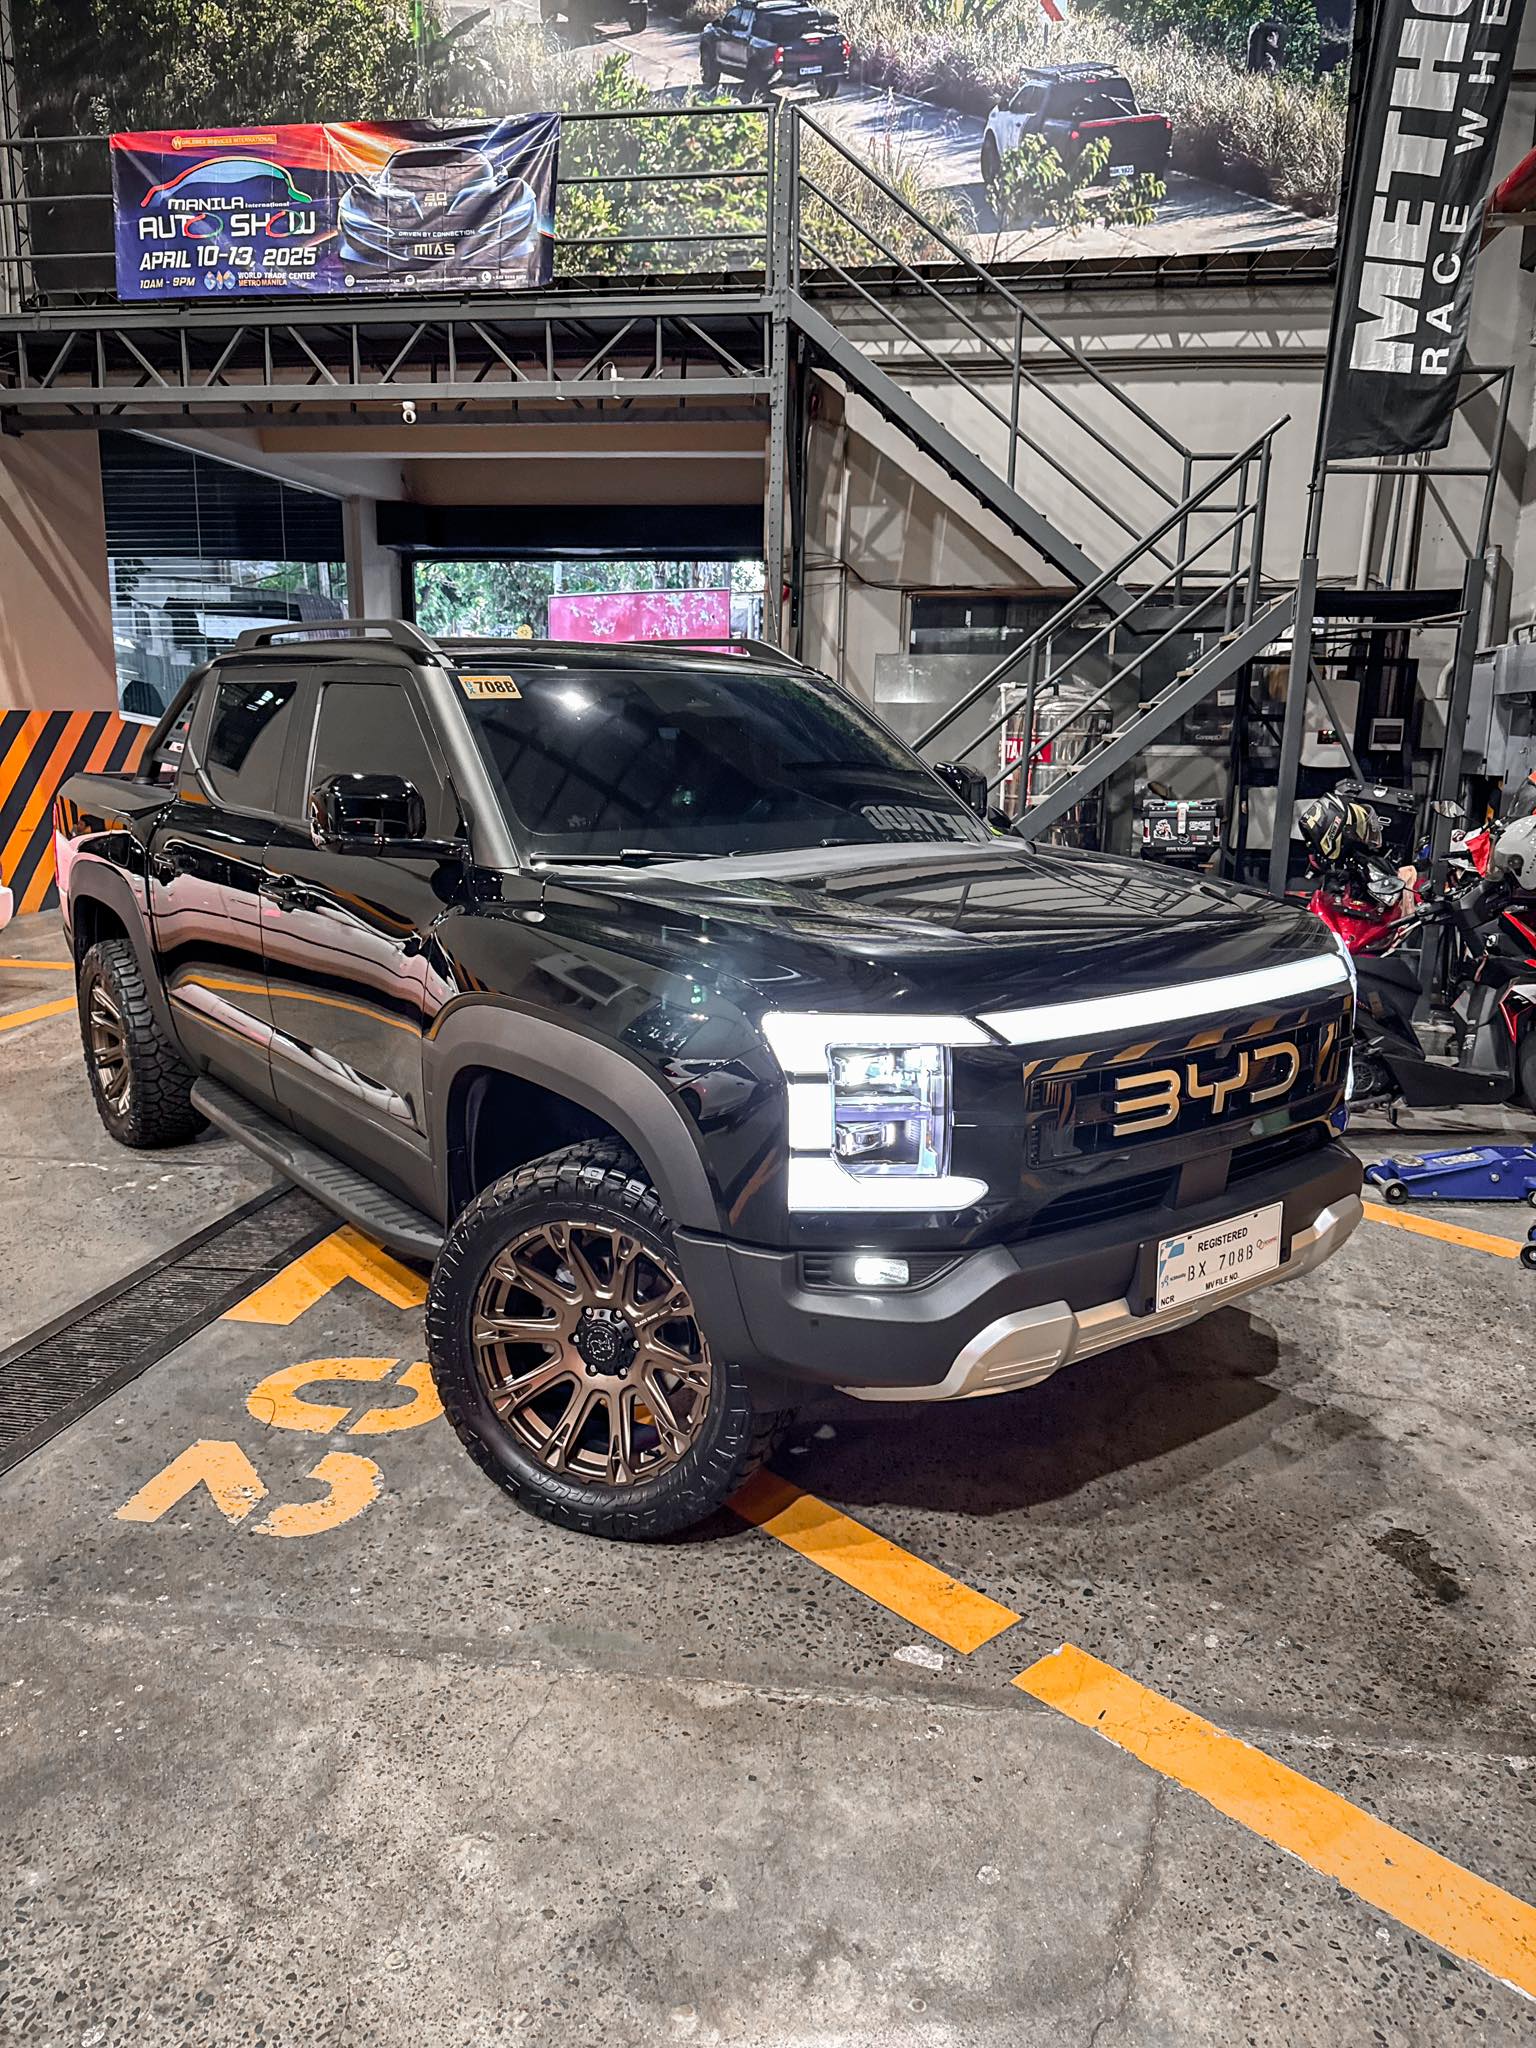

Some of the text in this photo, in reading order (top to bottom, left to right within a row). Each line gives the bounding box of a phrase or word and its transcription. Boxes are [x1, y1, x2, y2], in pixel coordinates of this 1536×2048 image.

[425, 192, 447, 201] 20
[1349, 0, 1472, 375] METH
[168, 196, 244, 211] MANILA
[139, 210, 316, 240] AUTO SHOW
[398, 230, 421, 238] DRIVEN
[432, 229, 476, 238] CONNECTION
[139, 245, 317, 271] APRIL 10-13, 2025
[414, 243, 455, 256] MIAS
[139, 277, 164, 289] 10AM
[172, 276, 196, 287] 9PM
[238, 271, 262, 279] WORLD
[264, 271, 287, 280] TRADE
[1420, 204, 1470, 375] RACE
[1113, 1041, 1300, 1138] BYD
[1197, 1227, 1249, 1253] REGISTERED
[1187, 1261, 1207, 1282] BX
[1205, 1272, 1240, 1291] MV FILE NO.
[1160, 1294, 1175, 1307] NCR
